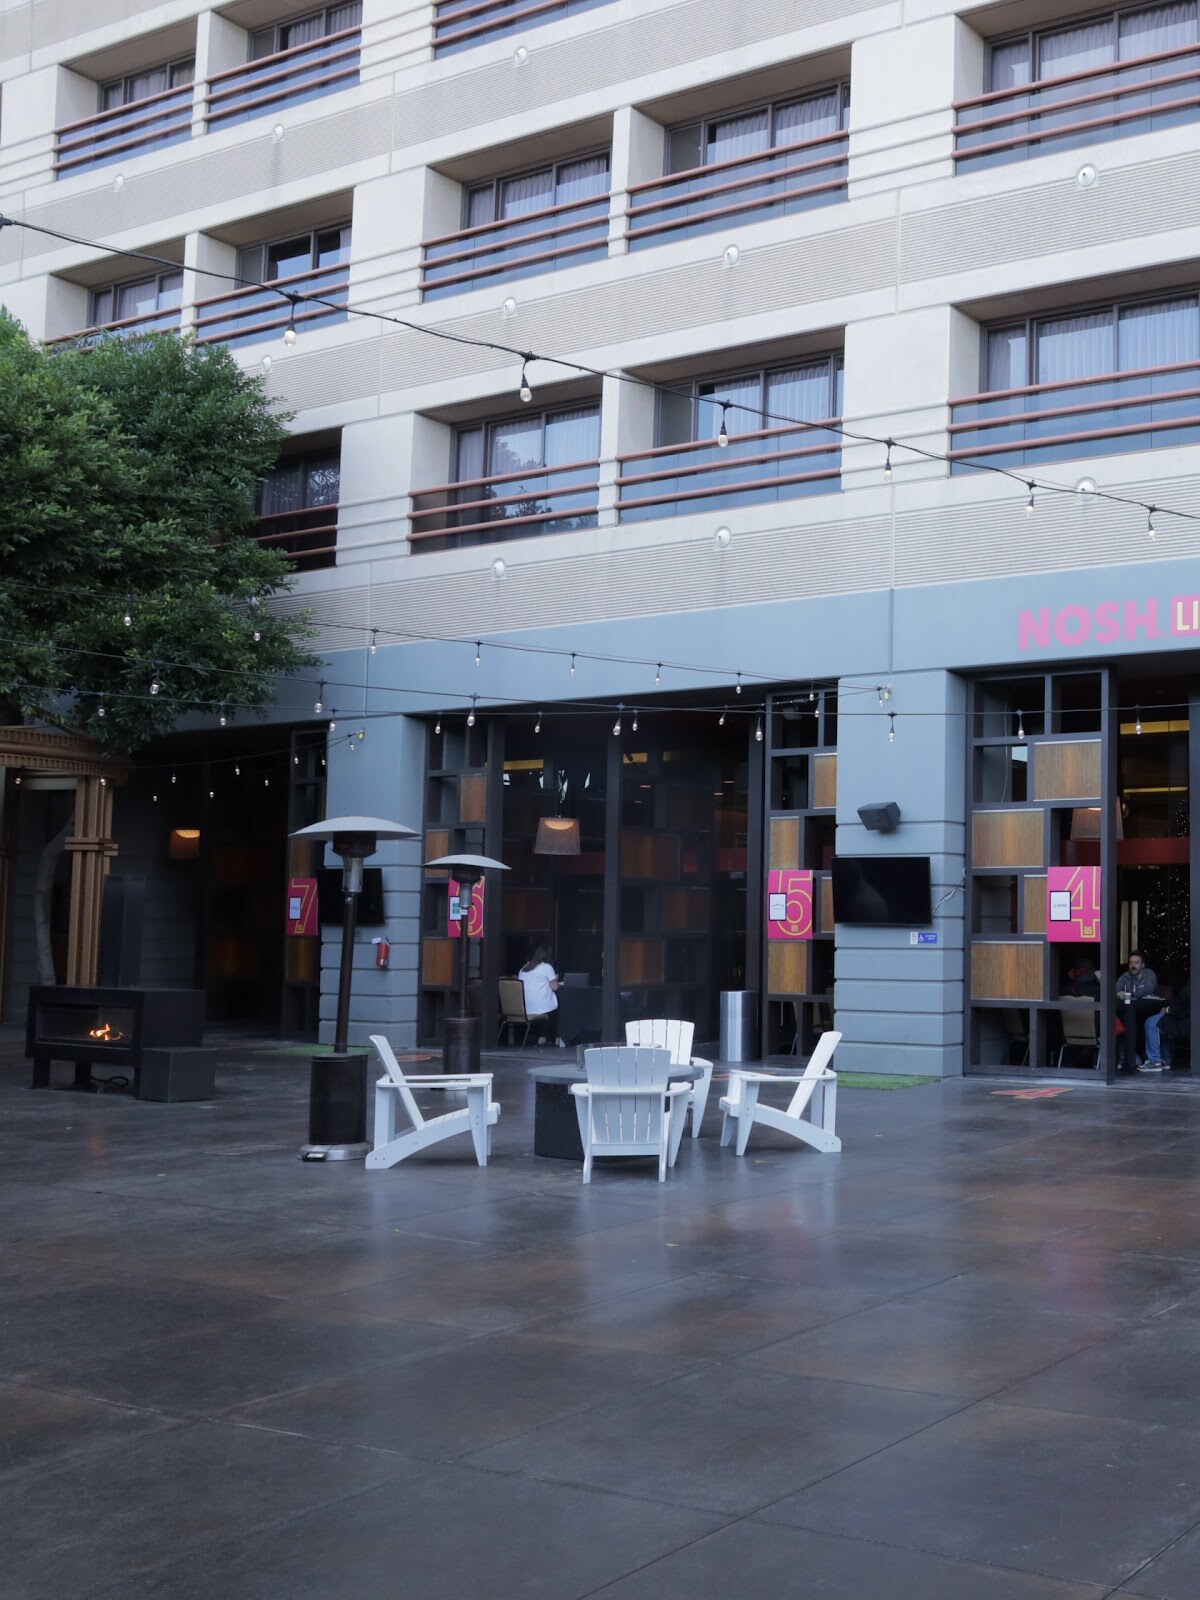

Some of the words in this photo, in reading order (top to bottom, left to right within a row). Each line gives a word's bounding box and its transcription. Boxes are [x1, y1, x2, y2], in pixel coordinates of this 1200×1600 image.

[291, 878, 318, 934] 7
[777, 869, 813, 935] 5
[1063, 866, 1101, 938] 4
